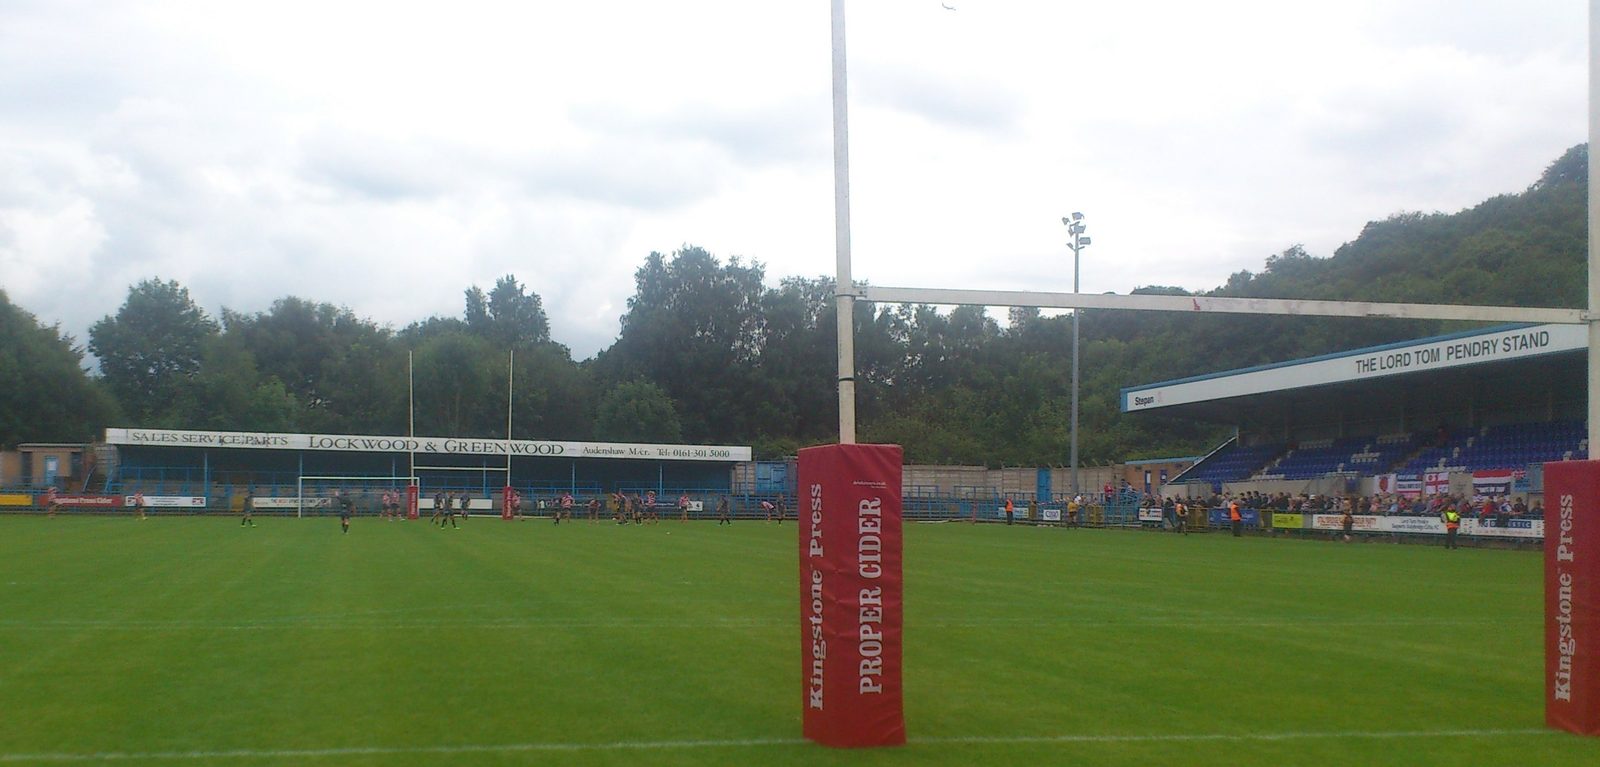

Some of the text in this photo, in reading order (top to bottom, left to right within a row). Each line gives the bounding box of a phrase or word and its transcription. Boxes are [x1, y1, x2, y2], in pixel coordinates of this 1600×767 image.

[1355, 330, 1550, 374] THE LORD TOM PENDRY STAND
[132, 432, 178, 442] SALES
[709, 449, 730, 458] 5000
[858, 496, 882, 579] CIDER
[809, 483, 827, 711] Kingstone Press
[1555, 494, 1576, 703] Kingstone Press
[858, 586, 883, 695] PROPER
